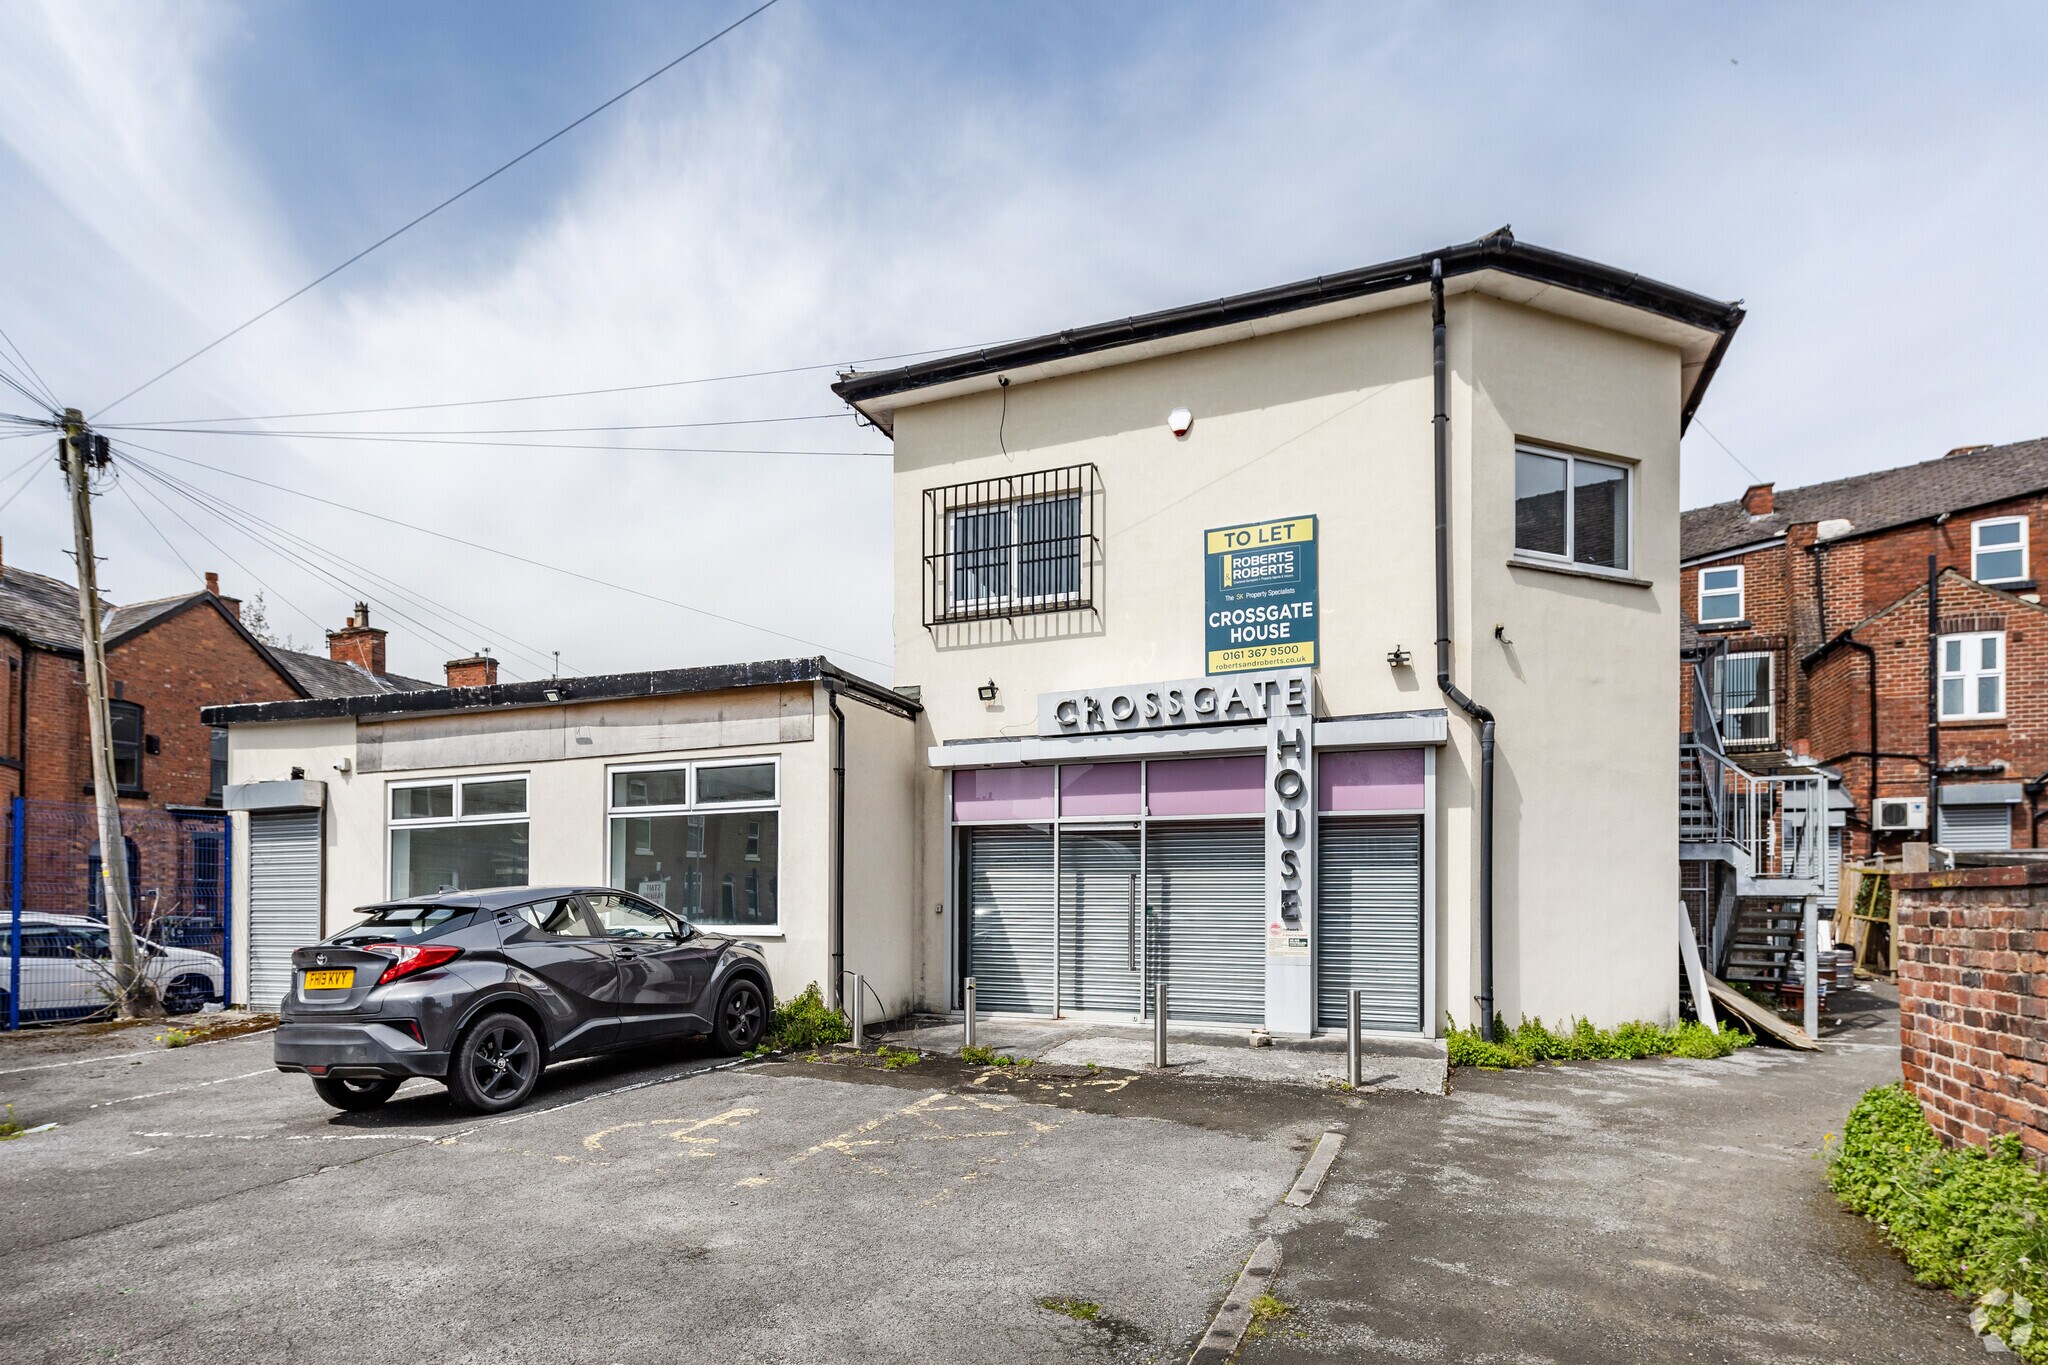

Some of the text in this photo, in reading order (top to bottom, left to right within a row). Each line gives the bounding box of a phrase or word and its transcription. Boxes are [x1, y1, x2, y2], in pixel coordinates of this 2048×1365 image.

[1224, 524, 1296, 548] TO LET
[1232, 551, 1294, 569] ROBERTS
[1225, 562, 1294, 581] & ROBERTS
[1245, 590, 1267, 599] Property
[1268, 587, 1296, 597] Specialists
[1208, 601, 1314, 628] CROSSGATE
[1230, 622, 1291, 644] HOUSE
[1222, 645, 1299, 661] 0161 367 9500
[1215, 656, 1307, 670] robertsandroberts.co.uk
[1054, 677, 1303, 726] CROSSGATE
[1274, 728, 1304, 921] HOUSE
[310, 972, 347, 985] FH19 KVY
